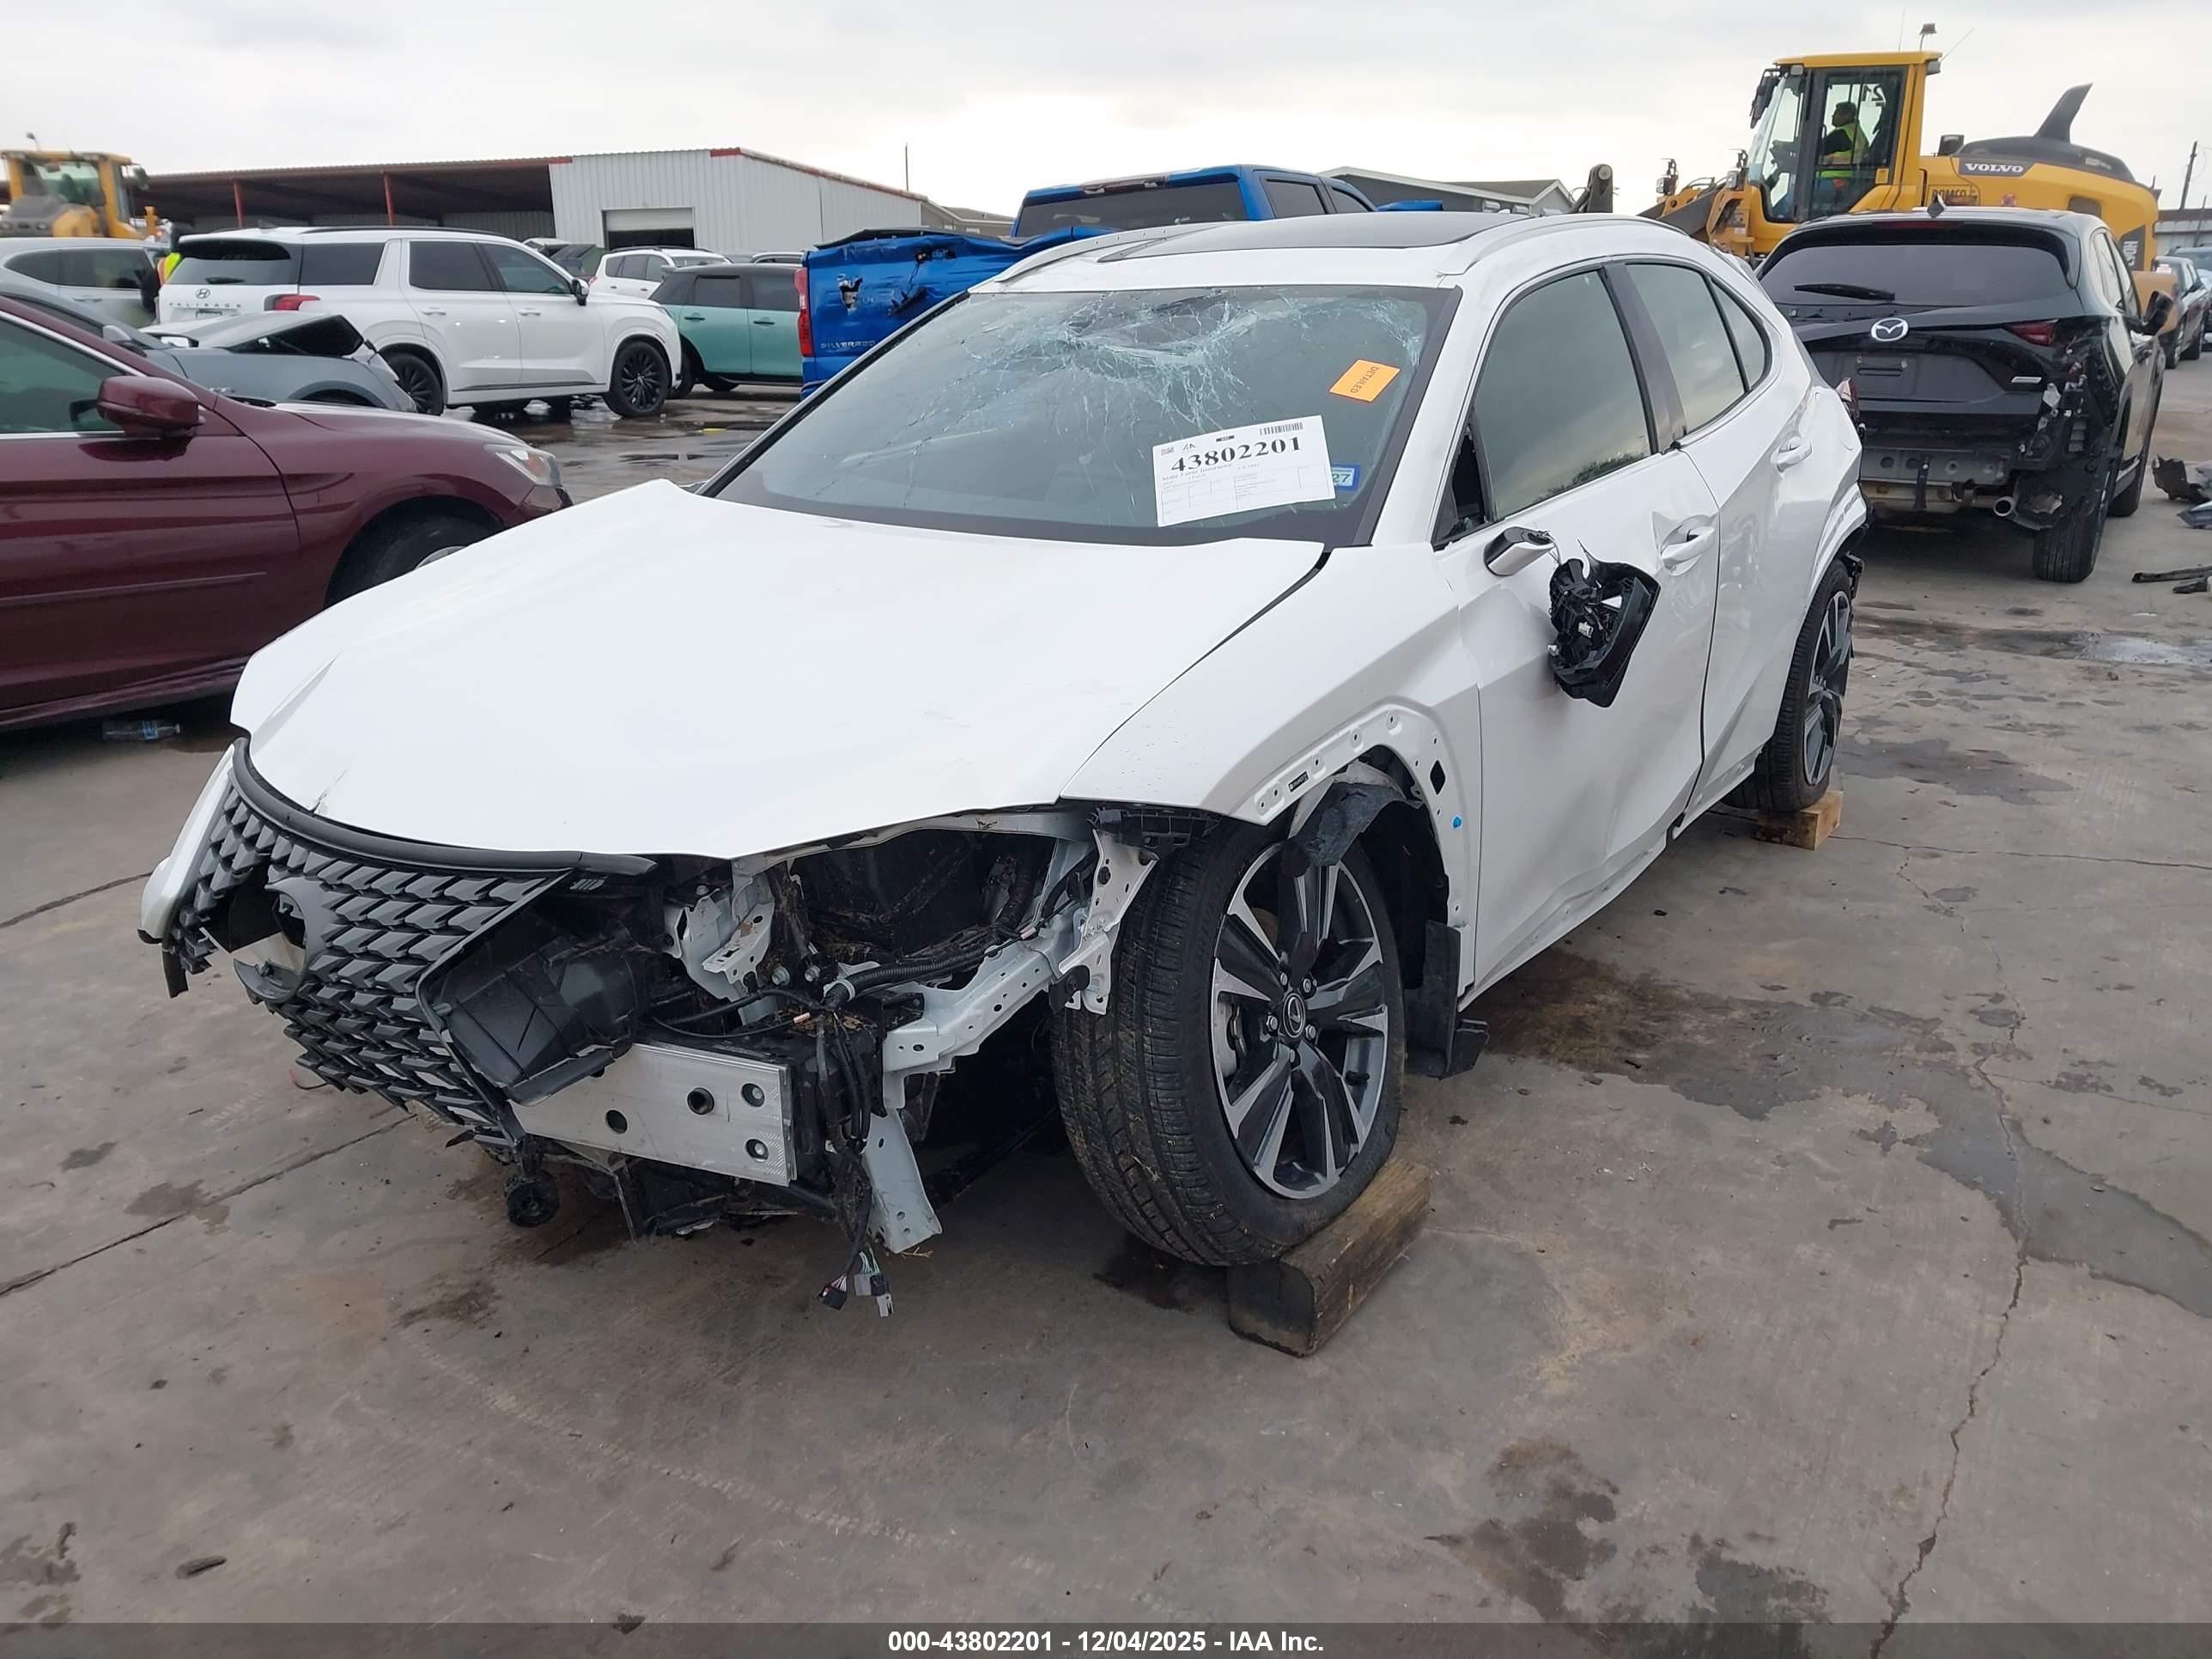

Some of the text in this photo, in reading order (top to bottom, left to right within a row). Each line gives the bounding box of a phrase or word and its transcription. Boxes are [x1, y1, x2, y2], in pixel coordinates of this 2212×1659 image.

[1964, 162, 2024, 173] VOLVO
[1350, 366, 1380, 393] DETAILED
[1171, 436, 1302, 471] 43802201
[1332, 473, 1352, 483] 27
